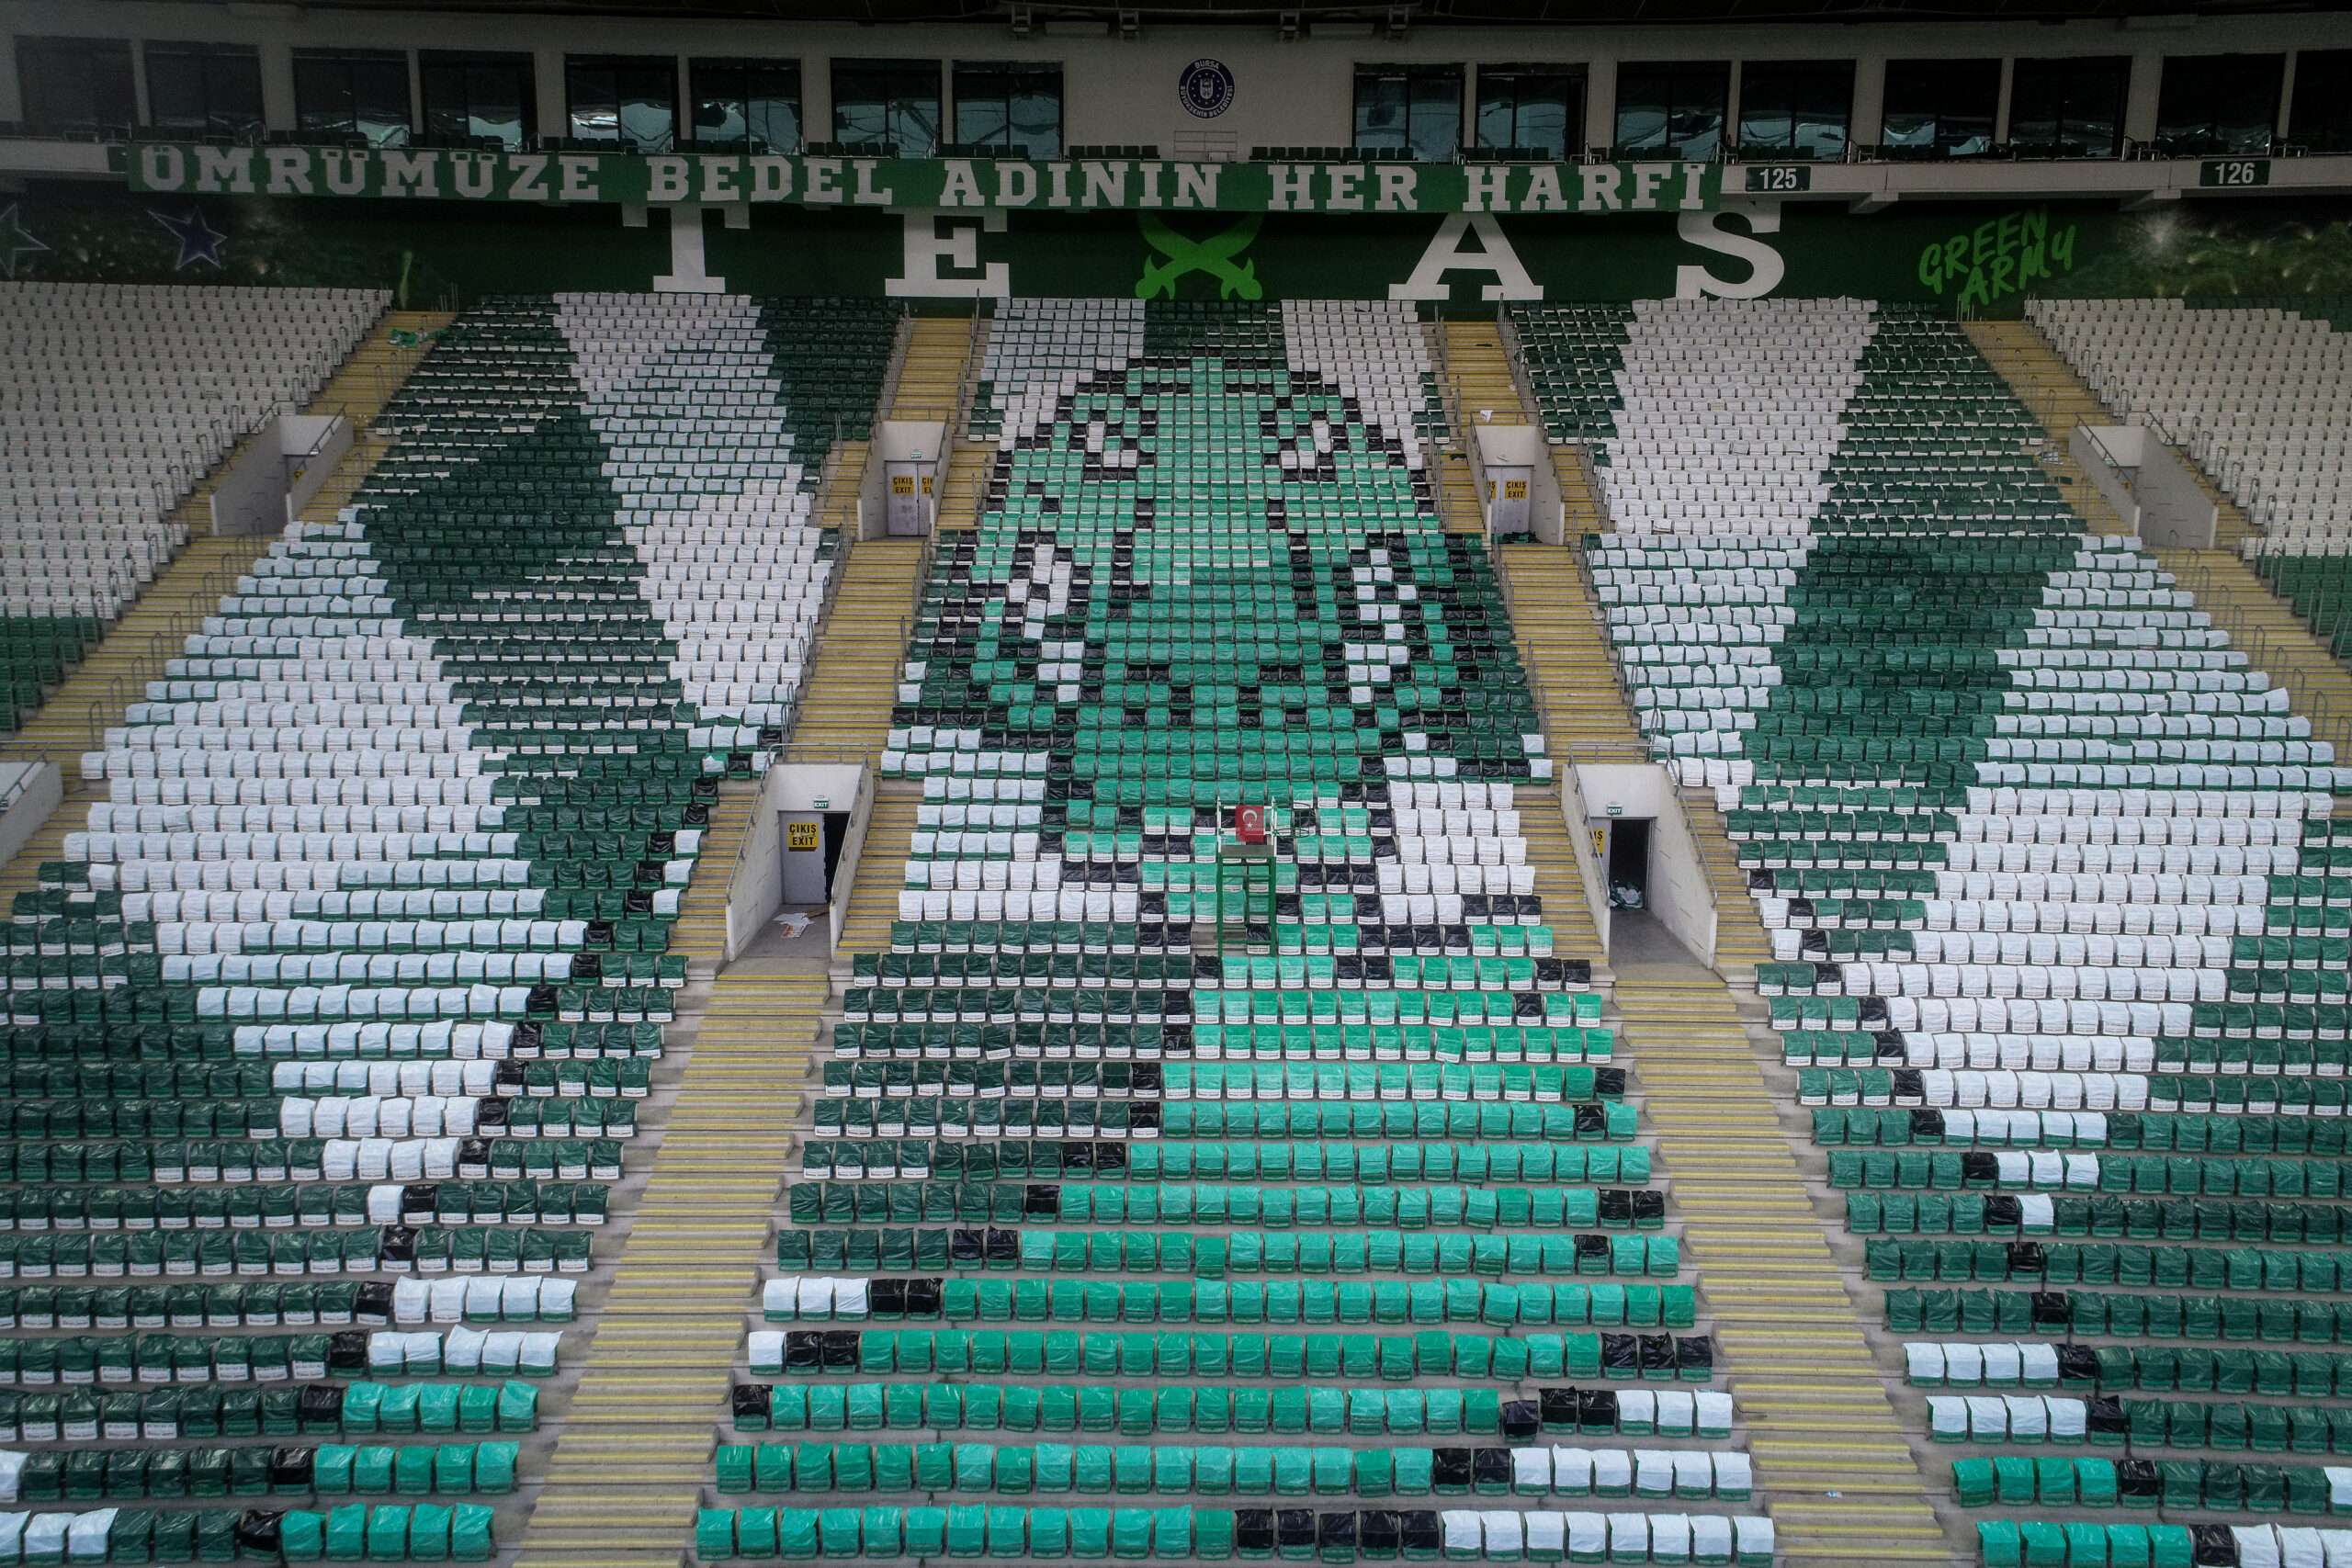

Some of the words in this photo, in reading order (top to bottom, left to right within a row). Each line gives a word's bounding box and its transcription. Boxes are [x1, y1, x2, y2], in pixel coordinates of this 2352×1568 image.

[1194, 60, 1219, 70] BURSA
[141, 144, 600, 201] ÖMRÜMÜZE
[646, 154, 893, 205] BEDEL
[939, 160, 1223, 208] ADININ
[1268, 164, 1419, 210] HER
[1759, 167, 1797, 190] 125
[2215, 162, 2256, 186] 126
[1918, 204, 2049, 295] GREEN
[1961, 223, 2077, 313] ARMY
[792, 837, 814, 846] EXIT
